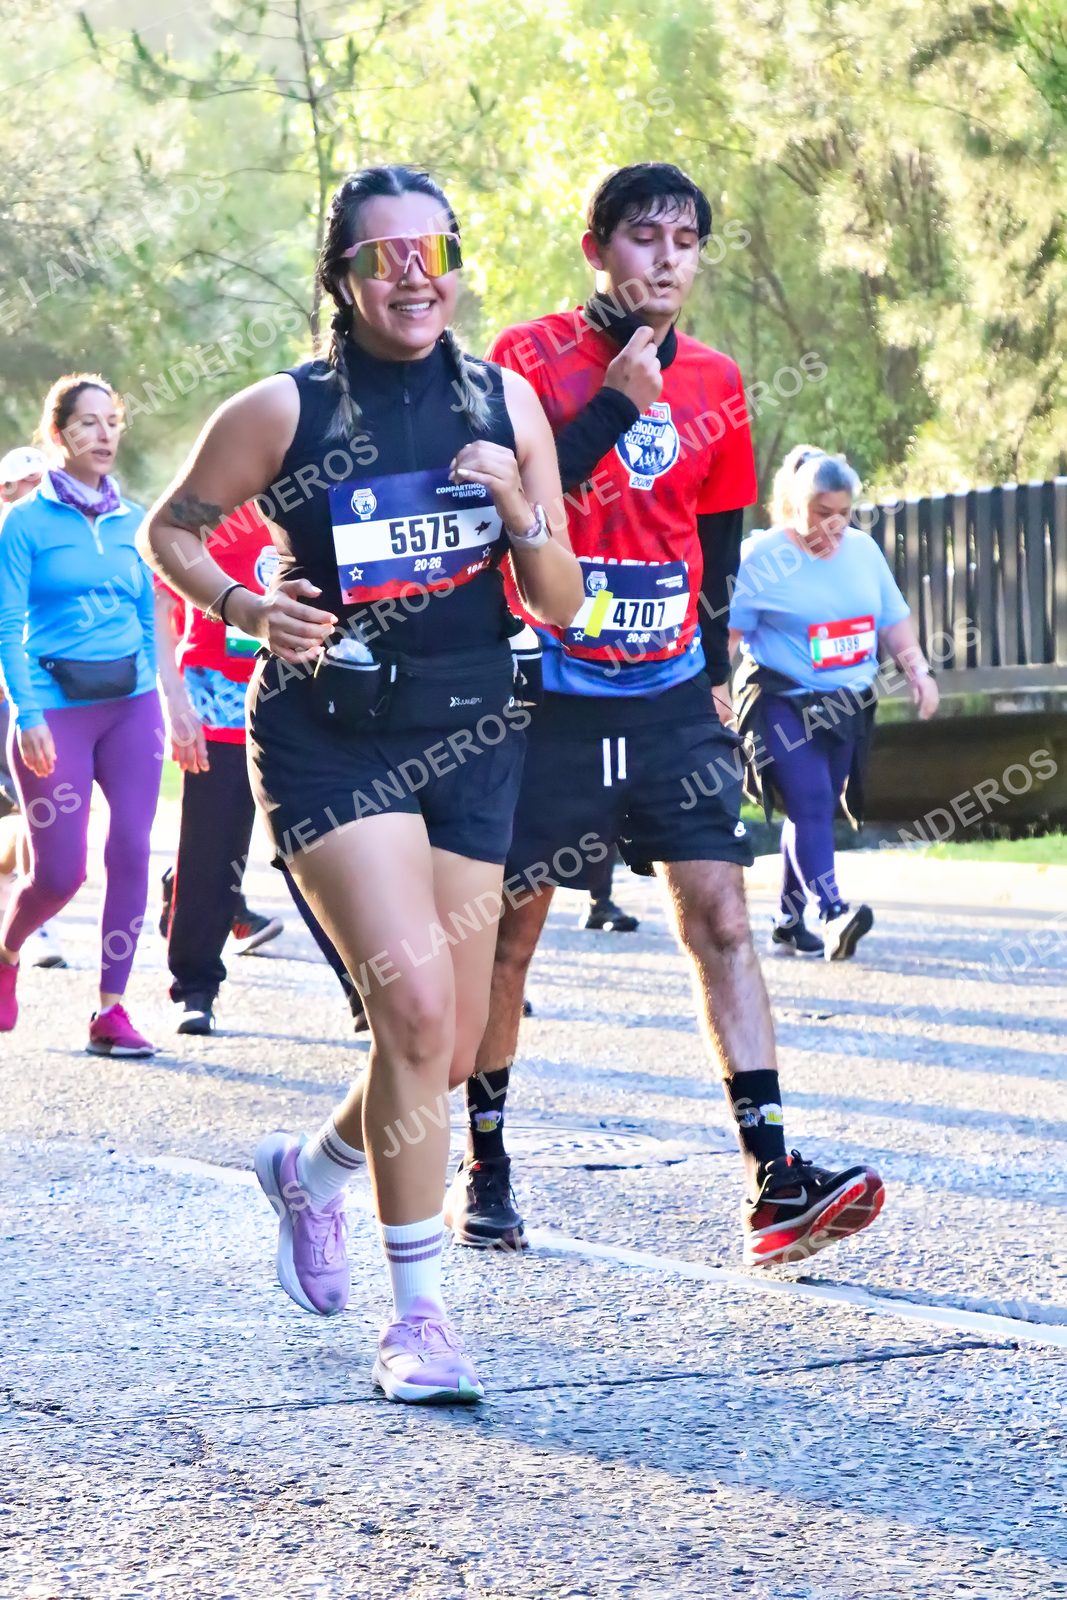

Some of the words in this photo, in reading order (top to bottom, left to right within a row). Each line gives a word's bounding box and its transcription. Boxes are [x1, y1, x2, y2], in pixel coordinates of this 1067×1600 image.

[631, 420, 666, 438] Global
[624, 430, 653, 447] Race
[631, 475, 653, 488] 2026
[389, 514, 460, 555] 5575
[613, 602, 666, 628] 4707
